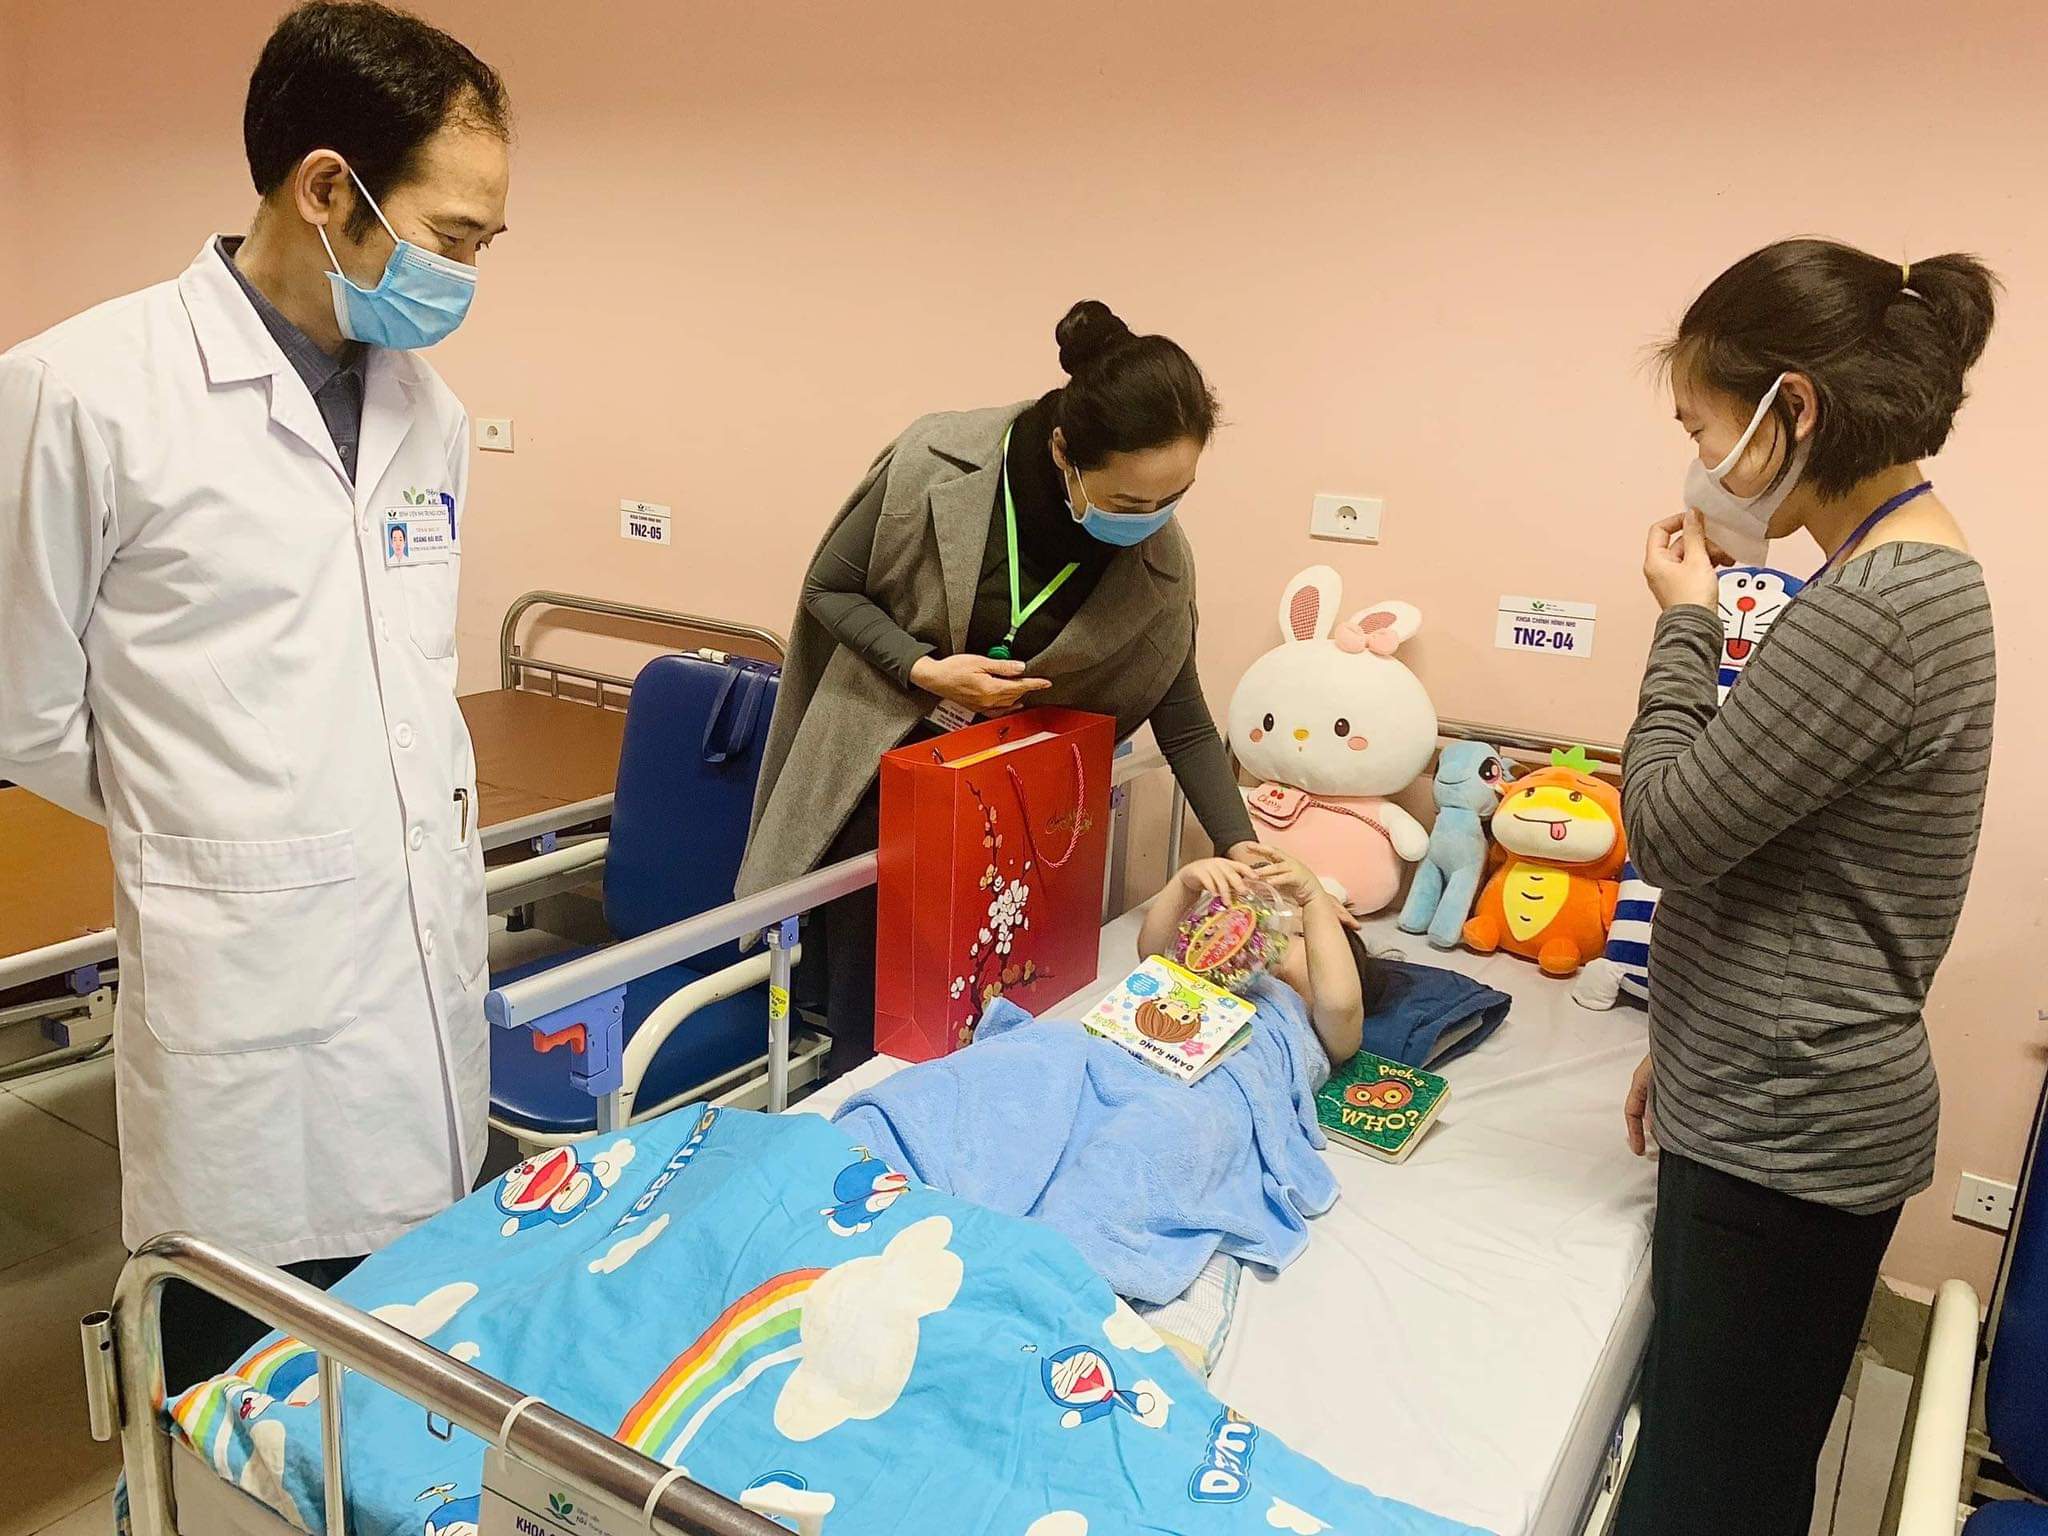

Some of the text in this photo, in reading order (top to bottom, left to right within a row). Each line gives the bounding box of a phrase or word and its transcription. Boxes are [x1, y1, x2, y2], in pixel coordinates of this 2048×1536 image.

[629, 522, 662, 540] TN2-05
[1513, 627, 1574, 650] TN2-04
[1342, 1107, 1420, 1132] WHO?
[516, 1515, 545, 1536] KHOA
